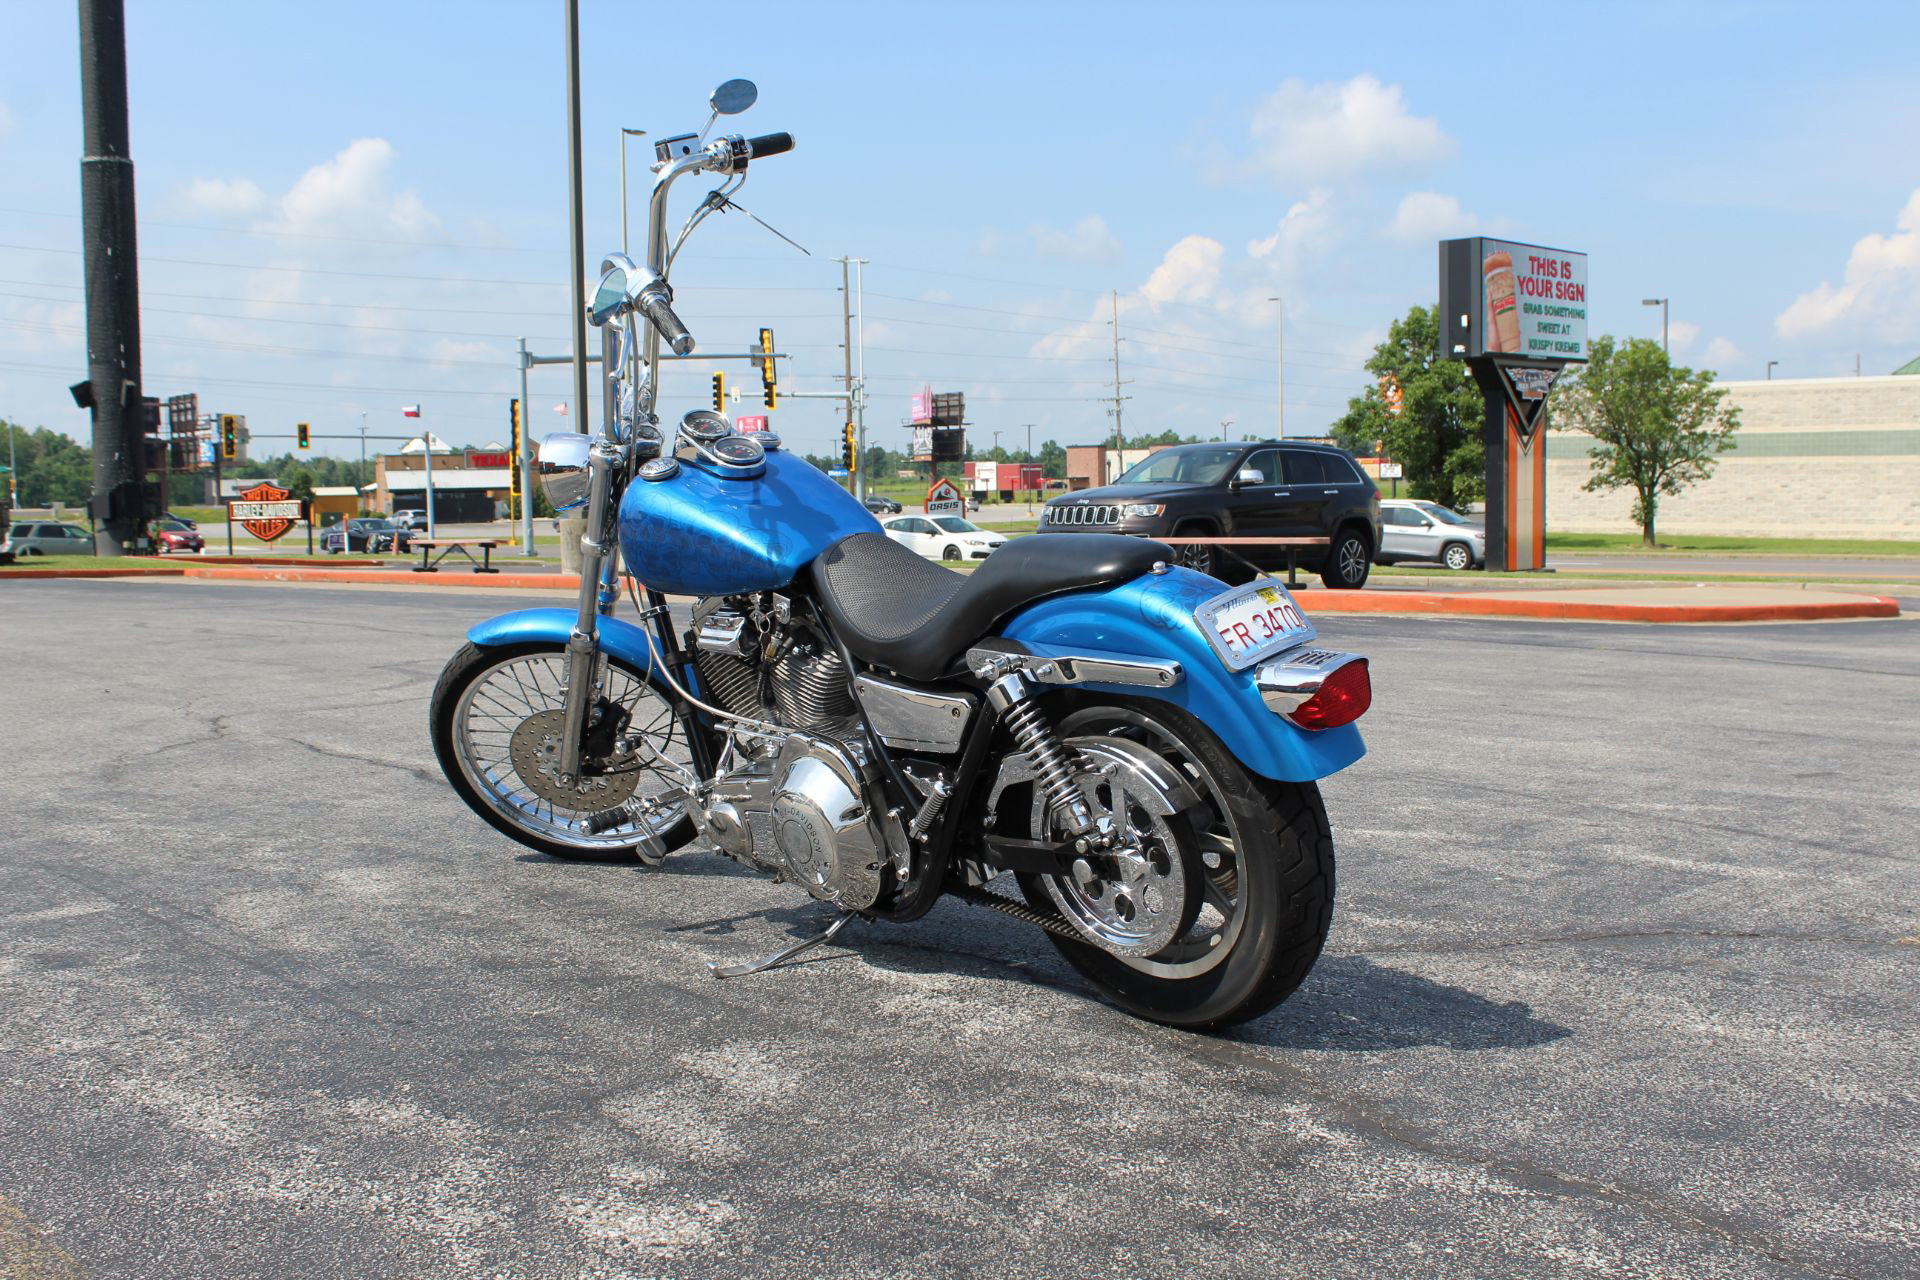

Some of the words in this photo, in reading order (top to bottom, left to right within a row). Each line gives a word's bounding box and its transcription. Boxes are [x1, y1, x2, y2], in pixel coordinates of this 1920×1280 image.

[1529, 256, 1557, 277] THIS
[1560, 261, 1571, 279] IS
[1517, 276, 1553, 298] YOUR
[1555, 281, 1585, 302] SIGN
[1523, 303, 1543, 315] GRAB
[1544, 305, 1585, 319] SOMETHING
[1537, 322, 1560, 334] SWEET
[1562, 324, 1571, 335] AT
[1529, 339, 1553, 351] KRISPY
[472, 454, 510, 467] TEXA
[246, 490, 282, 501] MOTOR
[232, 502, 299, 517] HARLEY-DAVIDSON
[930, 501, 959, 511] OASIS
[248, 519, 285, 534] CYCLES
[1252, 605, 1303, 639] 3470
